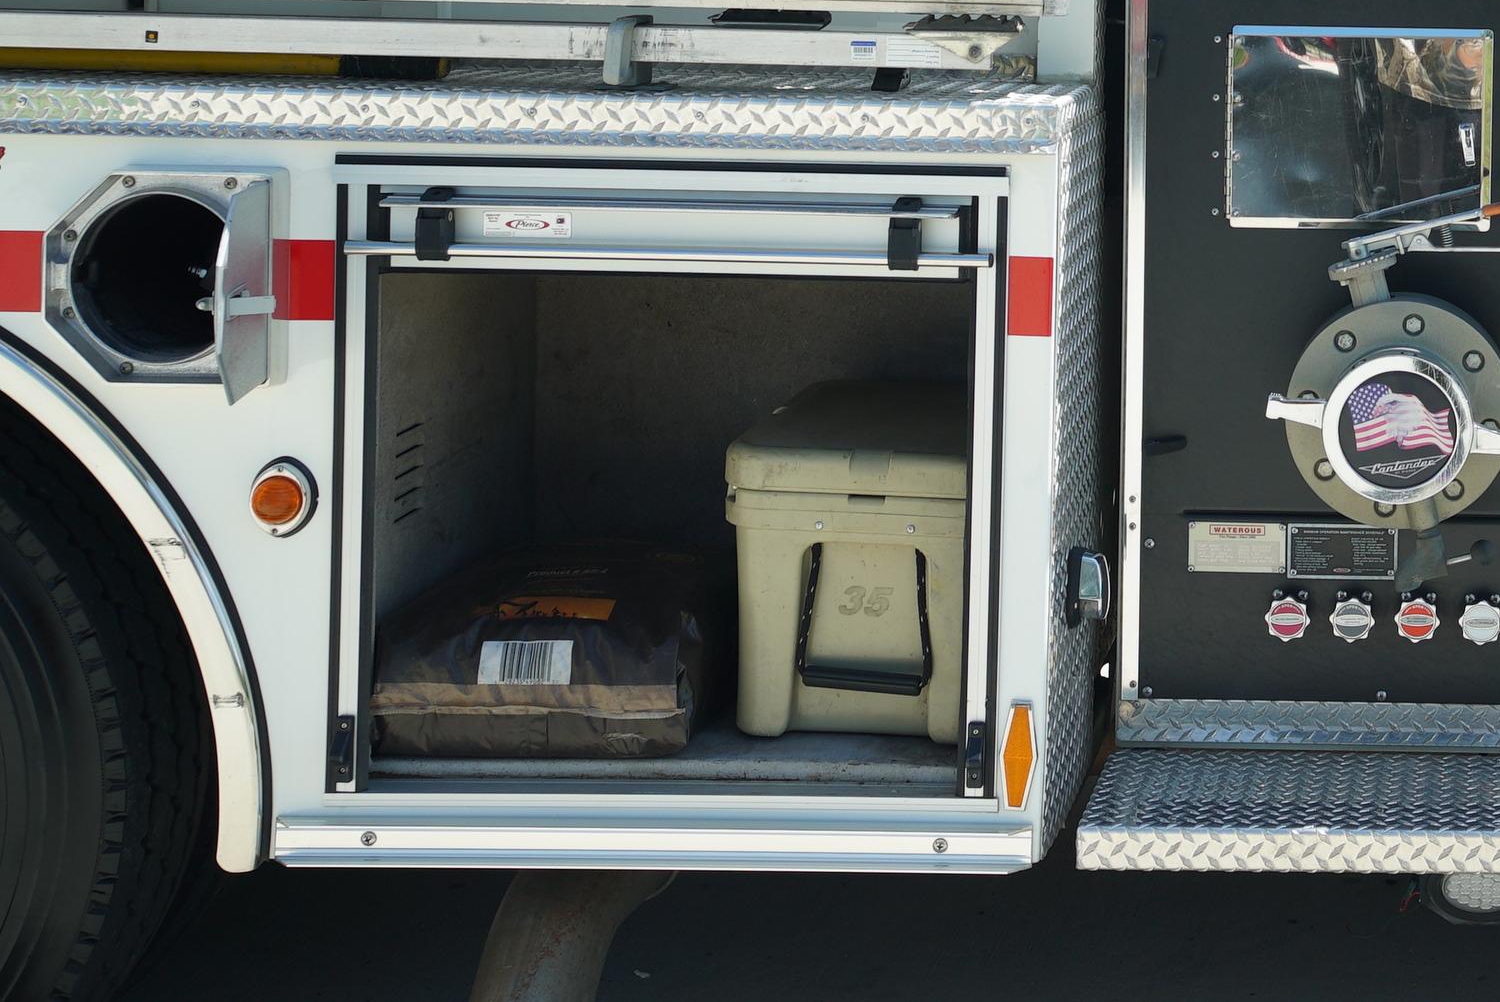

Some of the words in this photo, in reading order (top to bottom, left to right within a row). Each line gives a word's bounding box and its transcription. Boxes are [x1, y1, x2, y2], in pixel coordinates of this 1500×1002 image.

[515, 219, 540, 229] Pierce
[1371, 458, 1436, 474] Contender
[838, 585, 895, 618] 35
